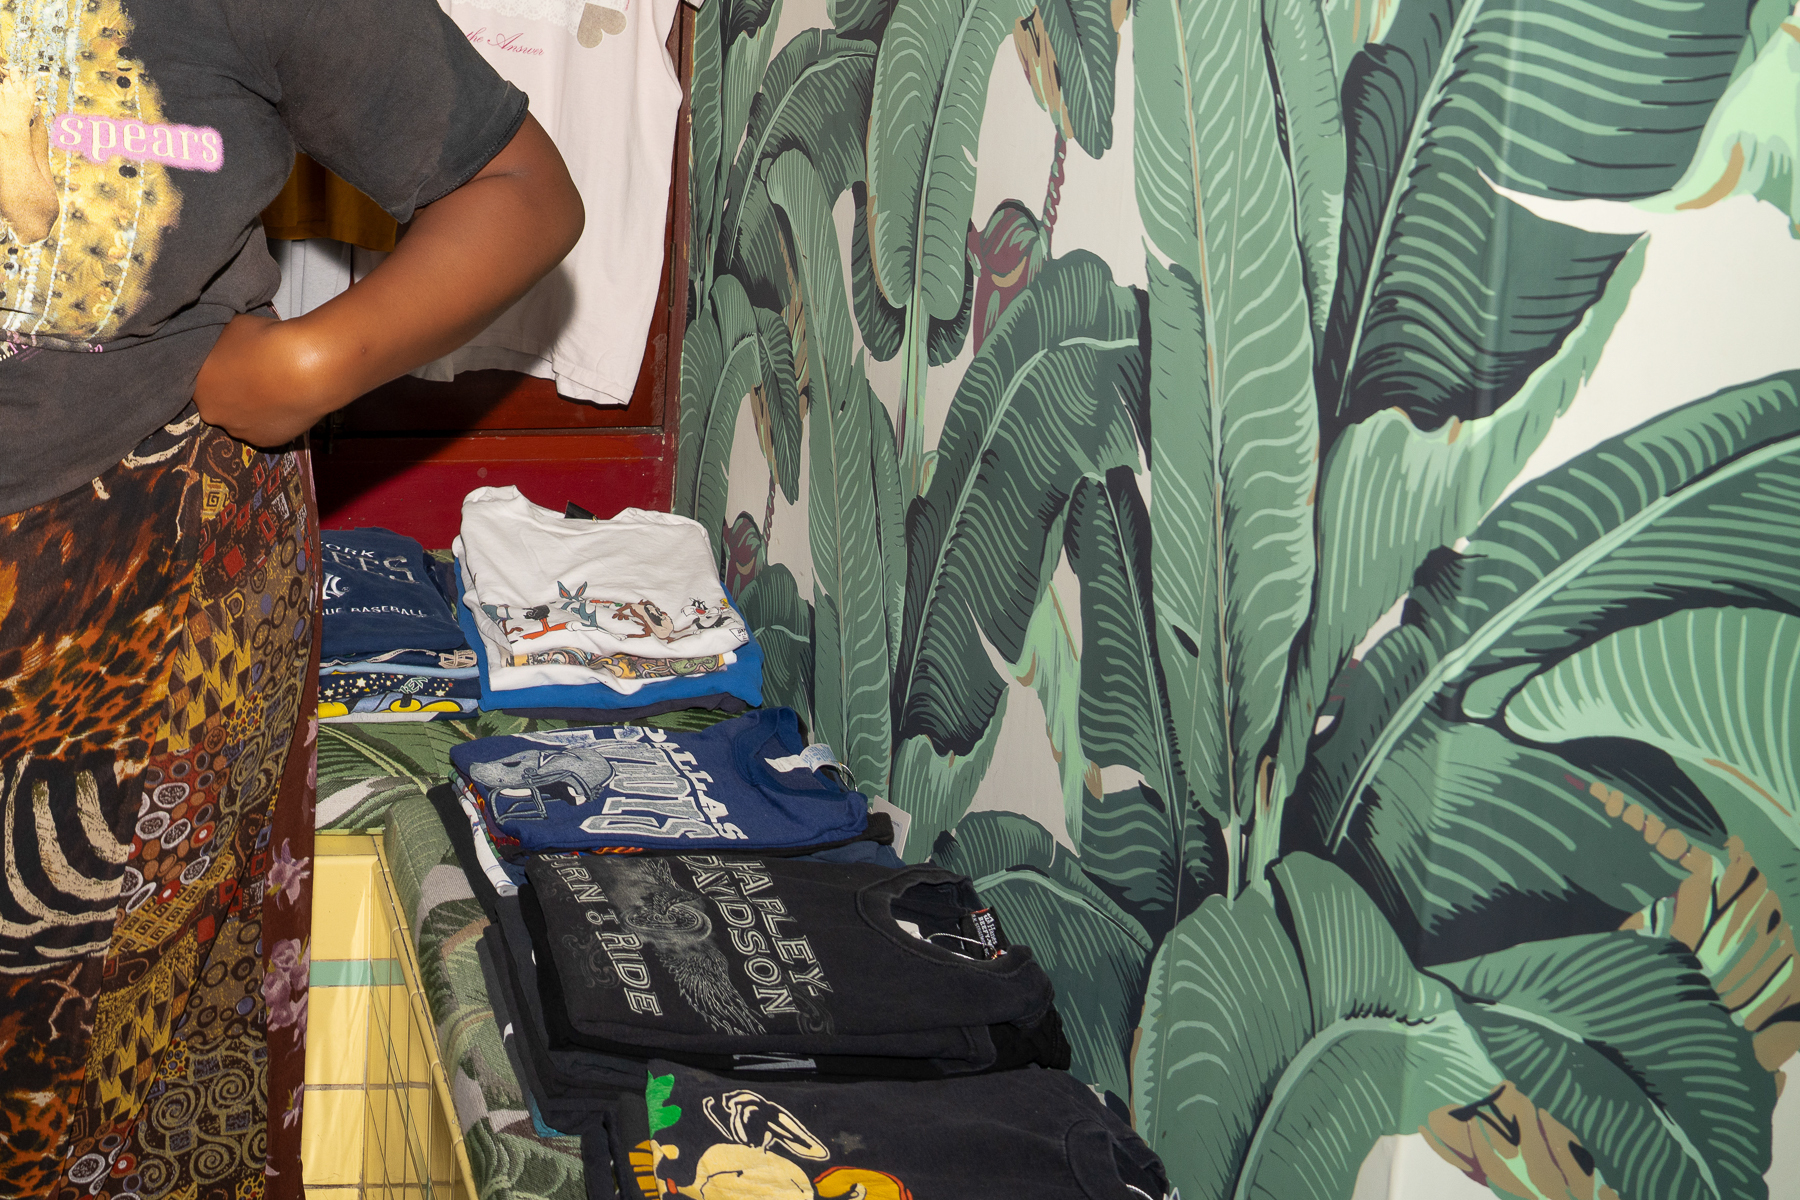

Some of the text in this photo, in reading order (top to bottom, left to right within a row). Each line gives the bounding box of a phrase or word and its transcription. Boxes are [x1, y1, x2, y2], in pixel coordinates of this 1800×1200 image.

[487, 32, 545, 56] Answer
[58, 116, 218, 163] spears
[643, 726, 749, 840] DALLAS
[596, 930, 663, 1017] RIDE
